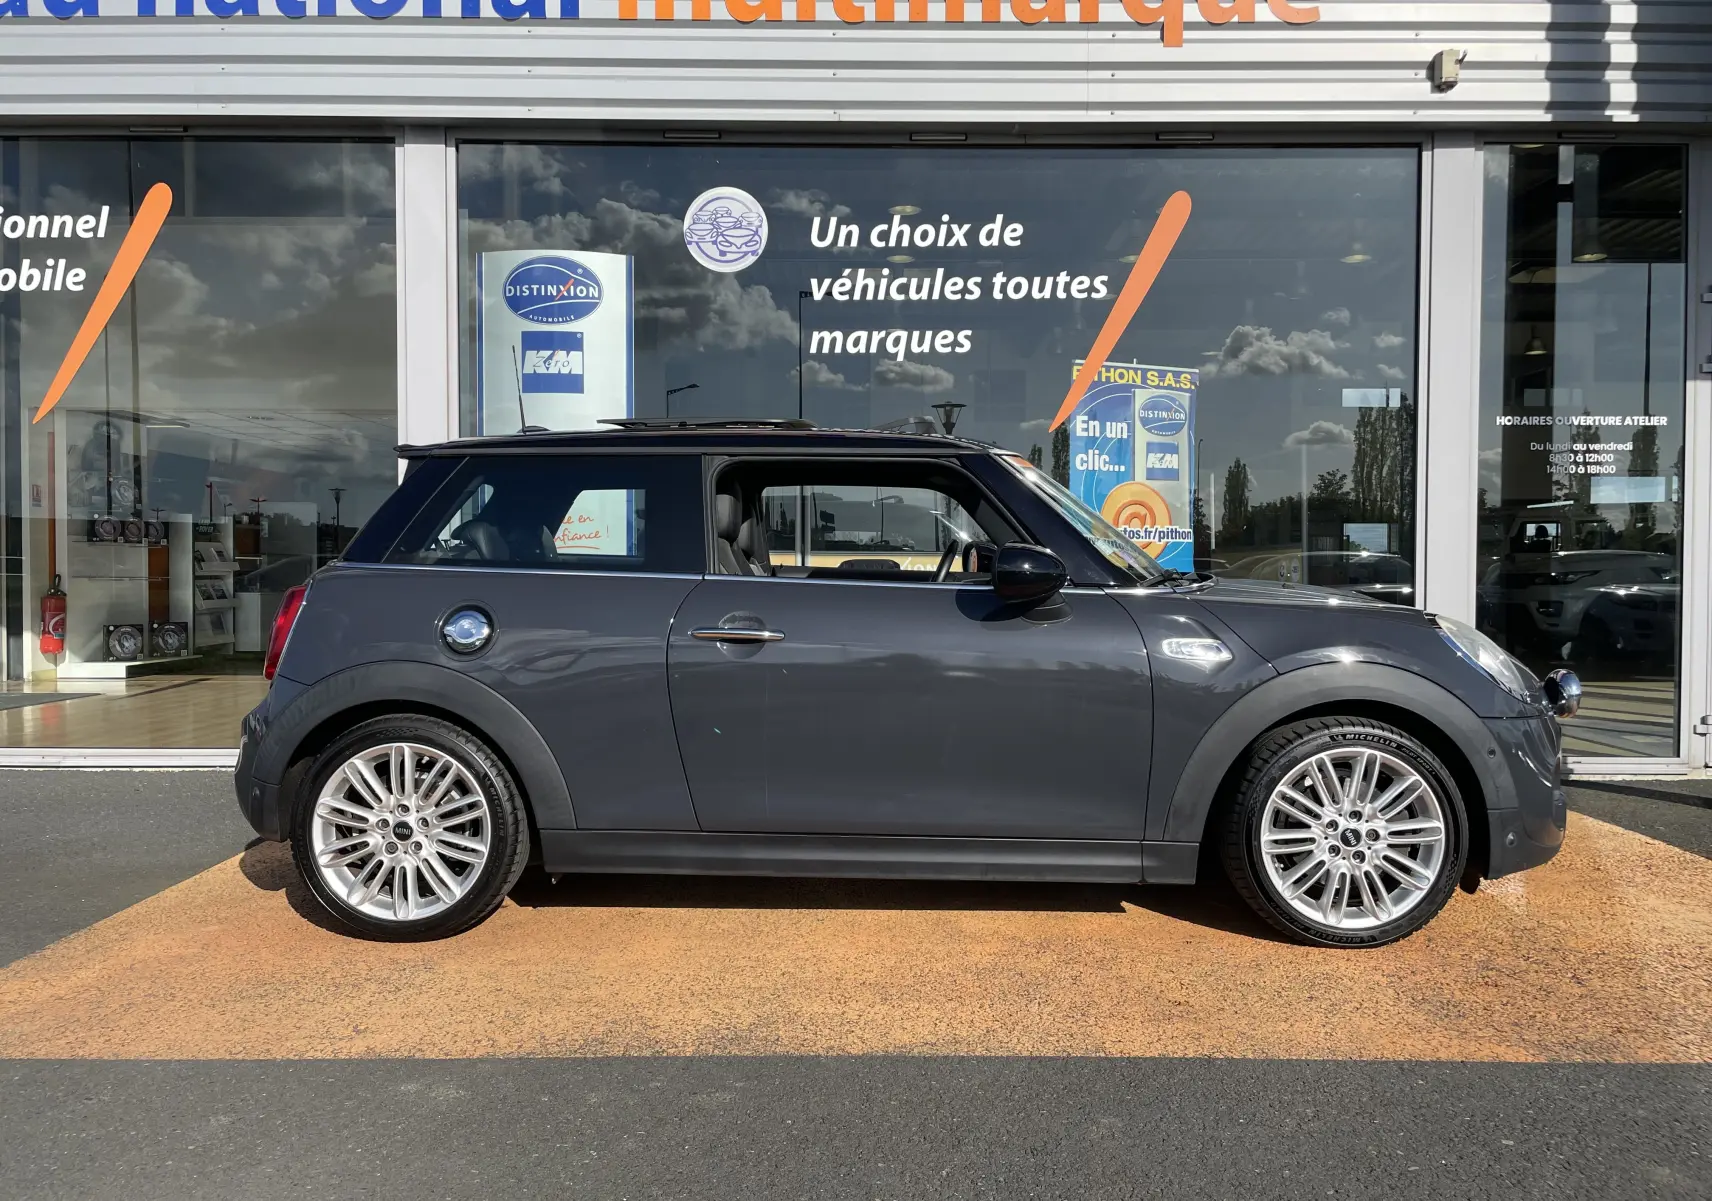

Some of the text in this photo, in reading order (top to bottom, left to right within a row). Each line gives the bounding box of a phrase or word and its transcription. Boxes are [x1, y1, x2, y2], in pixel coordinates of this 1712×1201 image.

[810, 214, 1024, 248] Un choix de
[506, 280, 599, 299] DISTINXION
[810, 268, 1109, 301] véhicules toutes
[529, 314, 575, 322] AUTOMOBILE
[809, 329, 973, 362] marques
[522, 350, 583, 375] KM
[1072, 365, 1195, 389] PTHON S.A.S.
[1140, 409, 1186, 420] DISTINXION
[1496, 416, 1668, 426] HORAIRES OUVERTURE ATELIER
[1076, 415, 1128, 439] En un
[1530, 442, 1633, 451] Du lundi au vendredi
[1075, 449, 1126, 471] clic...
[1549, 453, 1614, 462] 8h30 à 12h00
[1547, 465, 1616, 474] 14h00 à 18h00
[578, 515, 594, 523] en
[1121, 527, 1192, 542] tos.fr/pithon
[1345, 734, 1398, 748] MICHELIN
[395, 827, 411, 835] MINI
[1344, 829, 1357, 846] MINI
